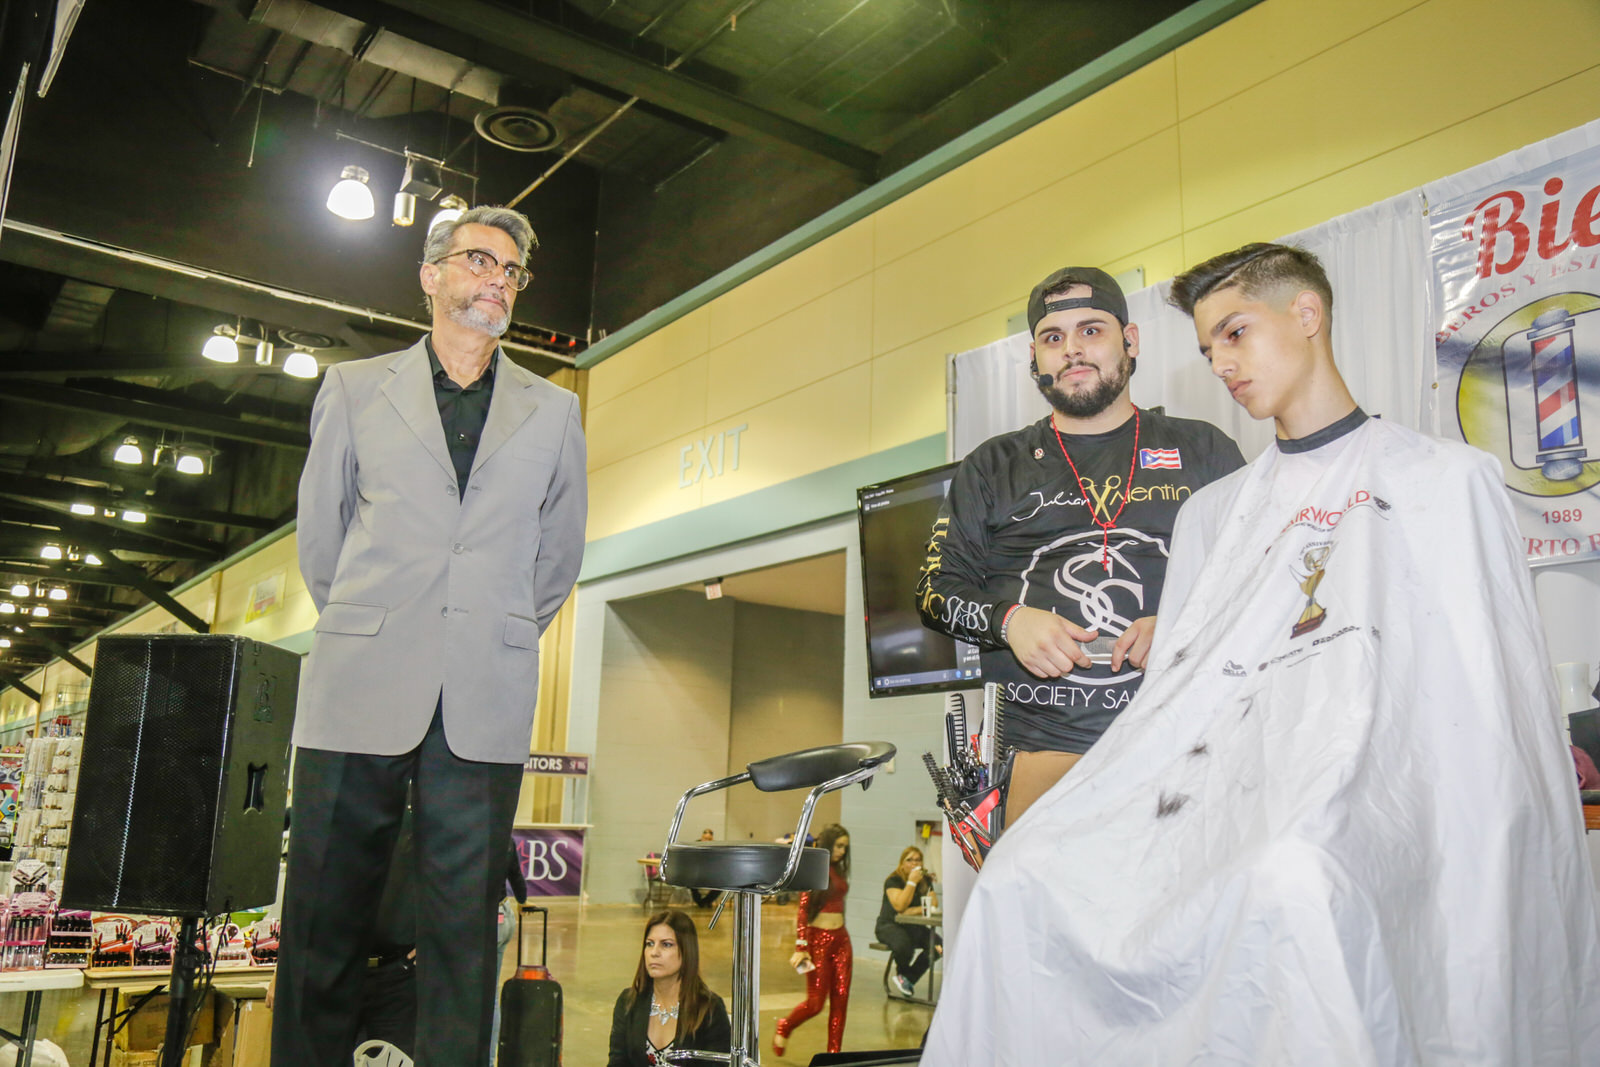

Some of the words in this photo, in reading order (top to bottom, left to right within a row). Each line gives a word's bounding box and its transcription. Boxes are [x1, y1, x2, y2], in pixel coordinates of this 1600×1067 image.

[679, 422, 749, 489] EXIT
[1011, 491, 1091, 521] Julian
[1542, 508, 1582, 524] 1989
[1522, 536, 1580, 557] RTO
[1005, 682, 1097, 708] SOCIETY
[1102, 688, 1138, 709] SA
